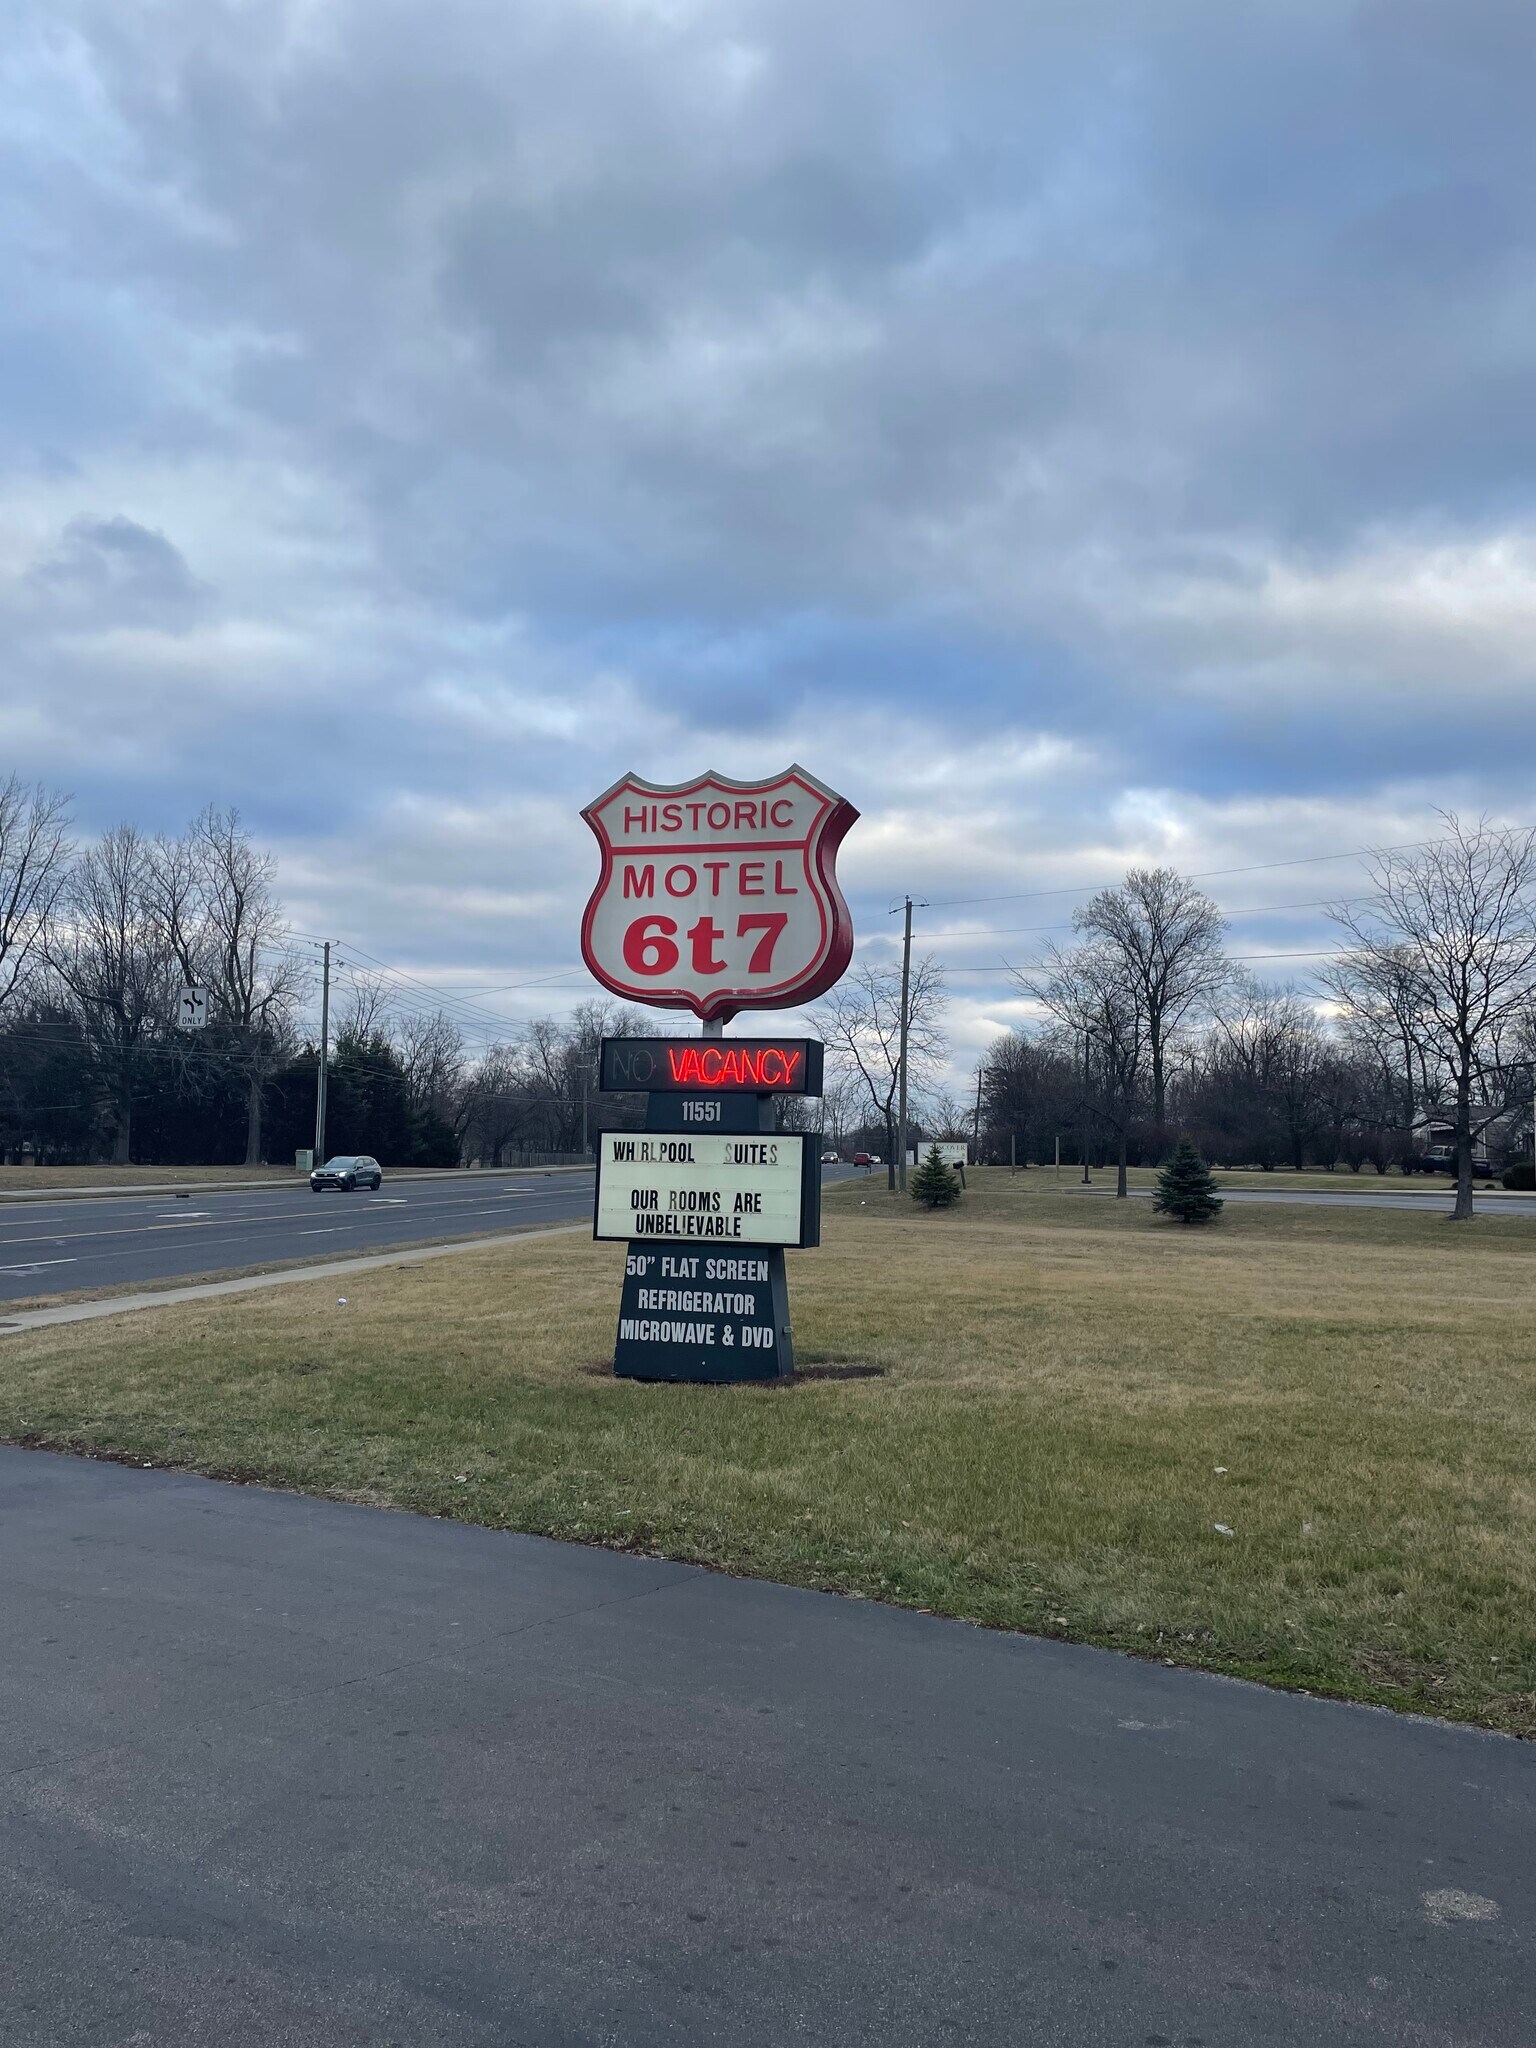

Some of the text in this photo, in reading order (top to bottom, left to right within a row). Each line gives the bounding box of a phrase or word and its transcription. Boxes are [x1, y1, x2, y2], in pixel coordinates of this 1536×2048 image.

[624, 800, 794, 833] HISTORIC
[623, 860, 798, 898] MOTEL
[622, 912, 788, 976] 6t7
[182, 1016, 202, 1025] ONLY
[612, 1048, 800, 1084] NO VACANCY
[682, 1101, 721, 1121] 11551
[725, 1143, 777, 1163] SUITES
[631, 1189, 761, 1213] OUR ROOMS ARE
[636, 1213, 741, 1236] UNBELIEVABLE
[661, 1256, 699, 1279] FLAT
[705, 1258, 769, 1281] SCREEN
[638, 1288, 755, 1315] REFRIGERATOR
[620, 1319, 774, 1348] MICROWAVE & DVD
